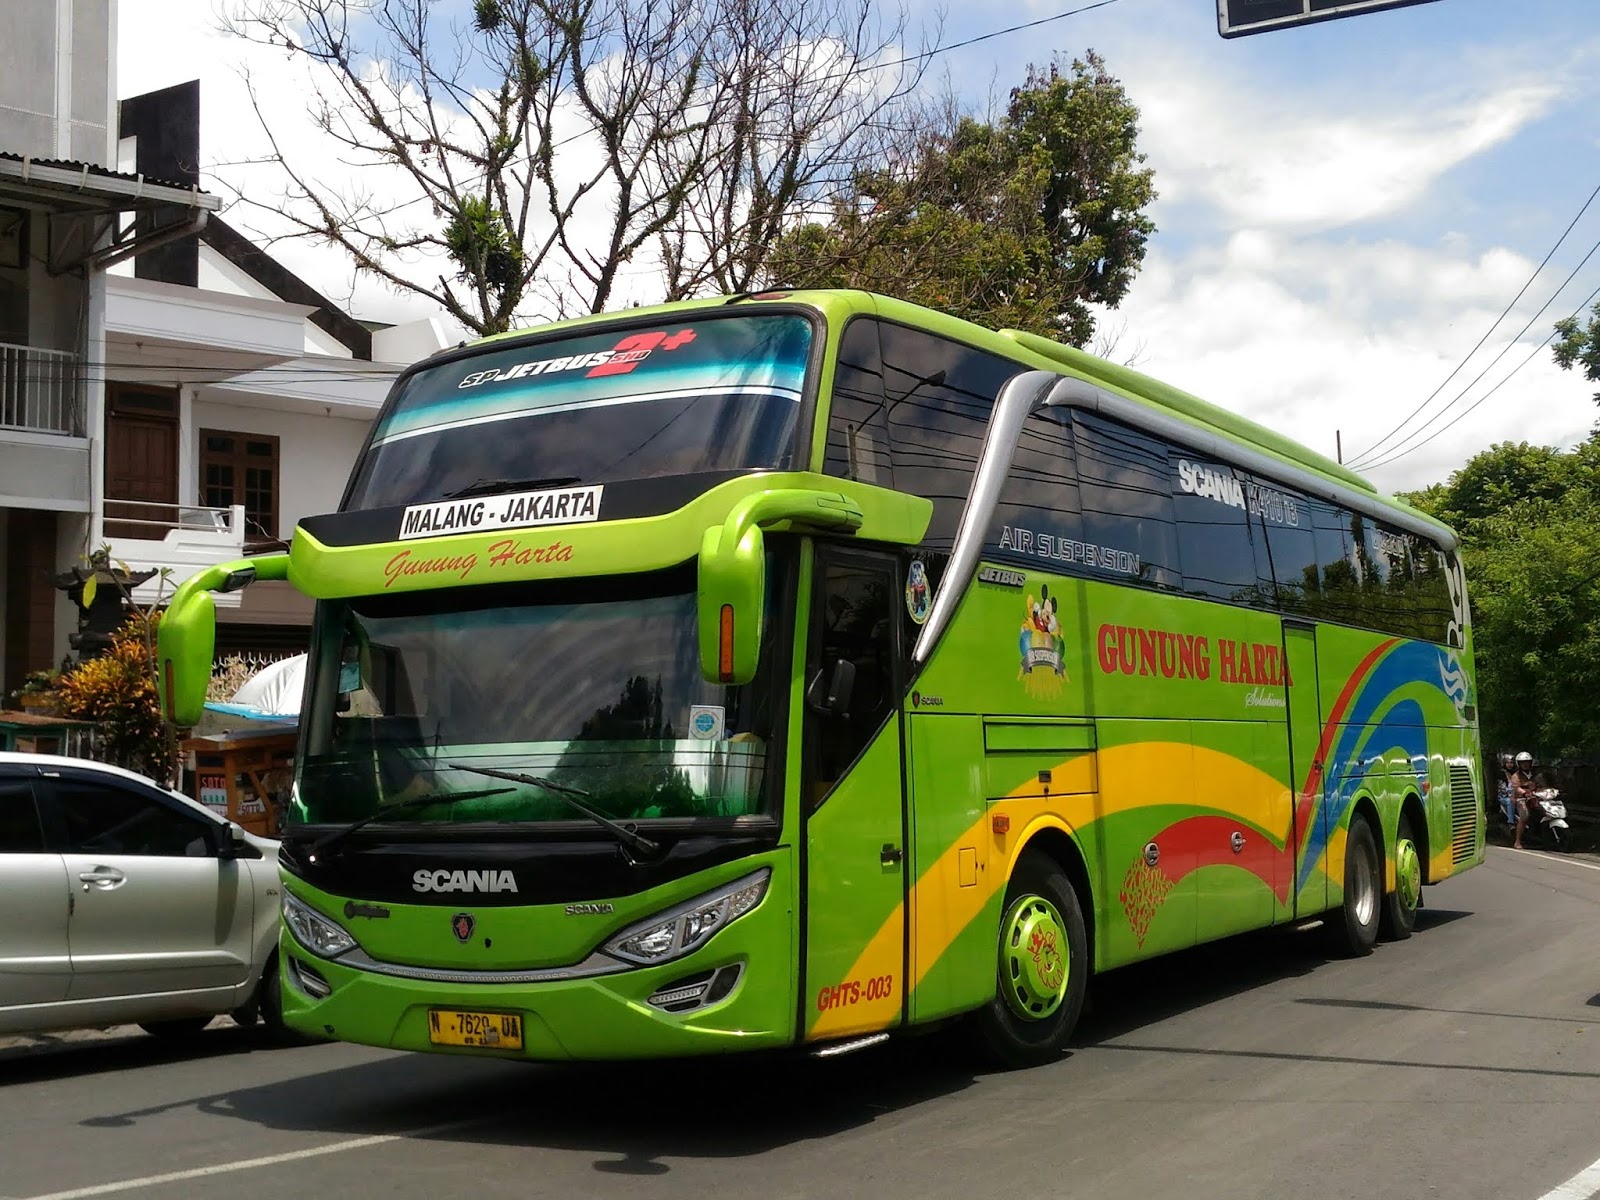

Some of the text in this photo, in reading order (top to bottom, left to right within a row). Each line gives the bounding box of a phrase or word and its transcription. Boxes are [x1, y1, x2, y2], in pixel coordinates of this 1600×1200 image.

[494, 350, 617, 382] JETBUS
[1178, 459, 1246, 510] SCANIA
[403, 502, 485, 535] MALANG
[500, 491, 595, 523] JAKARTA
[384, 539, 574, 588] Gunung Harta
[999, 526, 1140, 575] AIR SUSPENSION
[979, 567, 1027, 587] JETBUS
[1097, 623, 1294, 686] GUNUNG HARTA
[412, 869, 518, 893] SCANIA
[565, 903, 615, 916] SCANIA
[817, 975, 892, 1011] GHTS-003
[431, 1012, 440, 1033] N
[502, 1017, 519, 1038] UA
